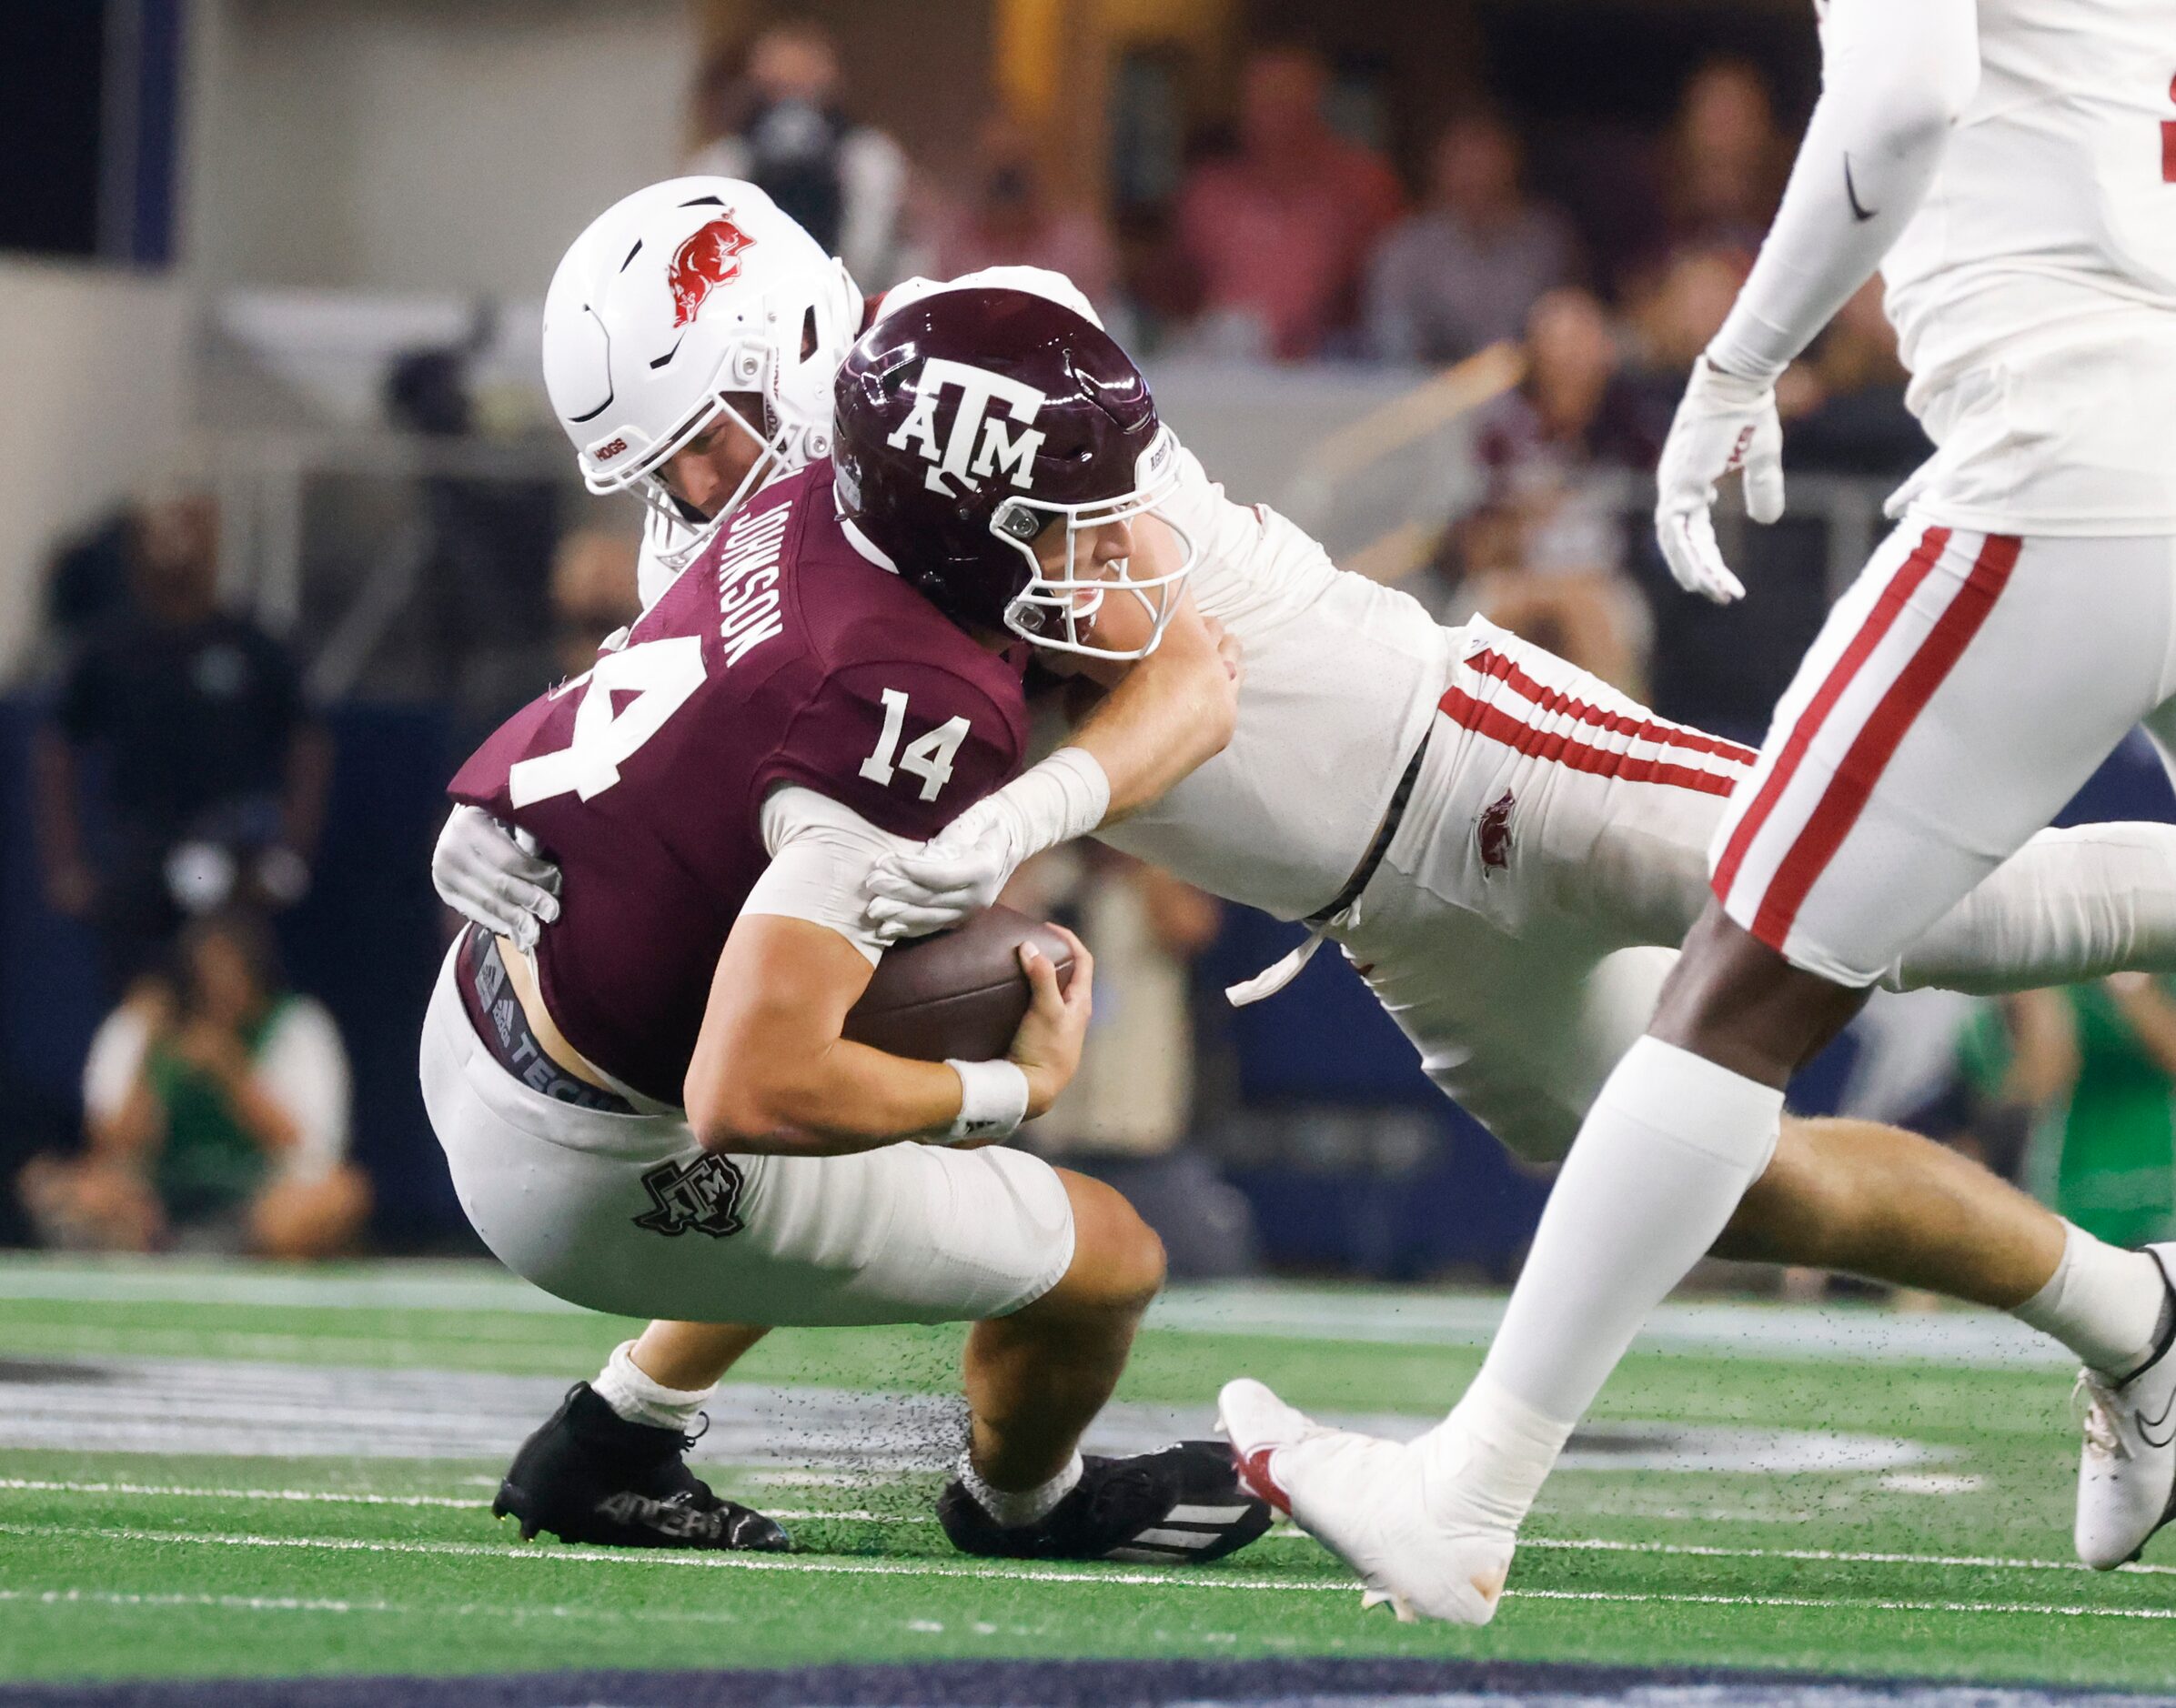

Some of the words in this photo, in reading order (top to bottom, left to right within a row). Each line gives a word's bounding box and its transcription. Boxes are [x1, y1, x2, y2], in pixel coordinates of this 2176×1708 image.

[594, 437, 628, 461] HOGS
[719, 500, 792, 668] JOHNSON
[509, 634, 708, 809] 4
[858, 688, 971, 802] 14
